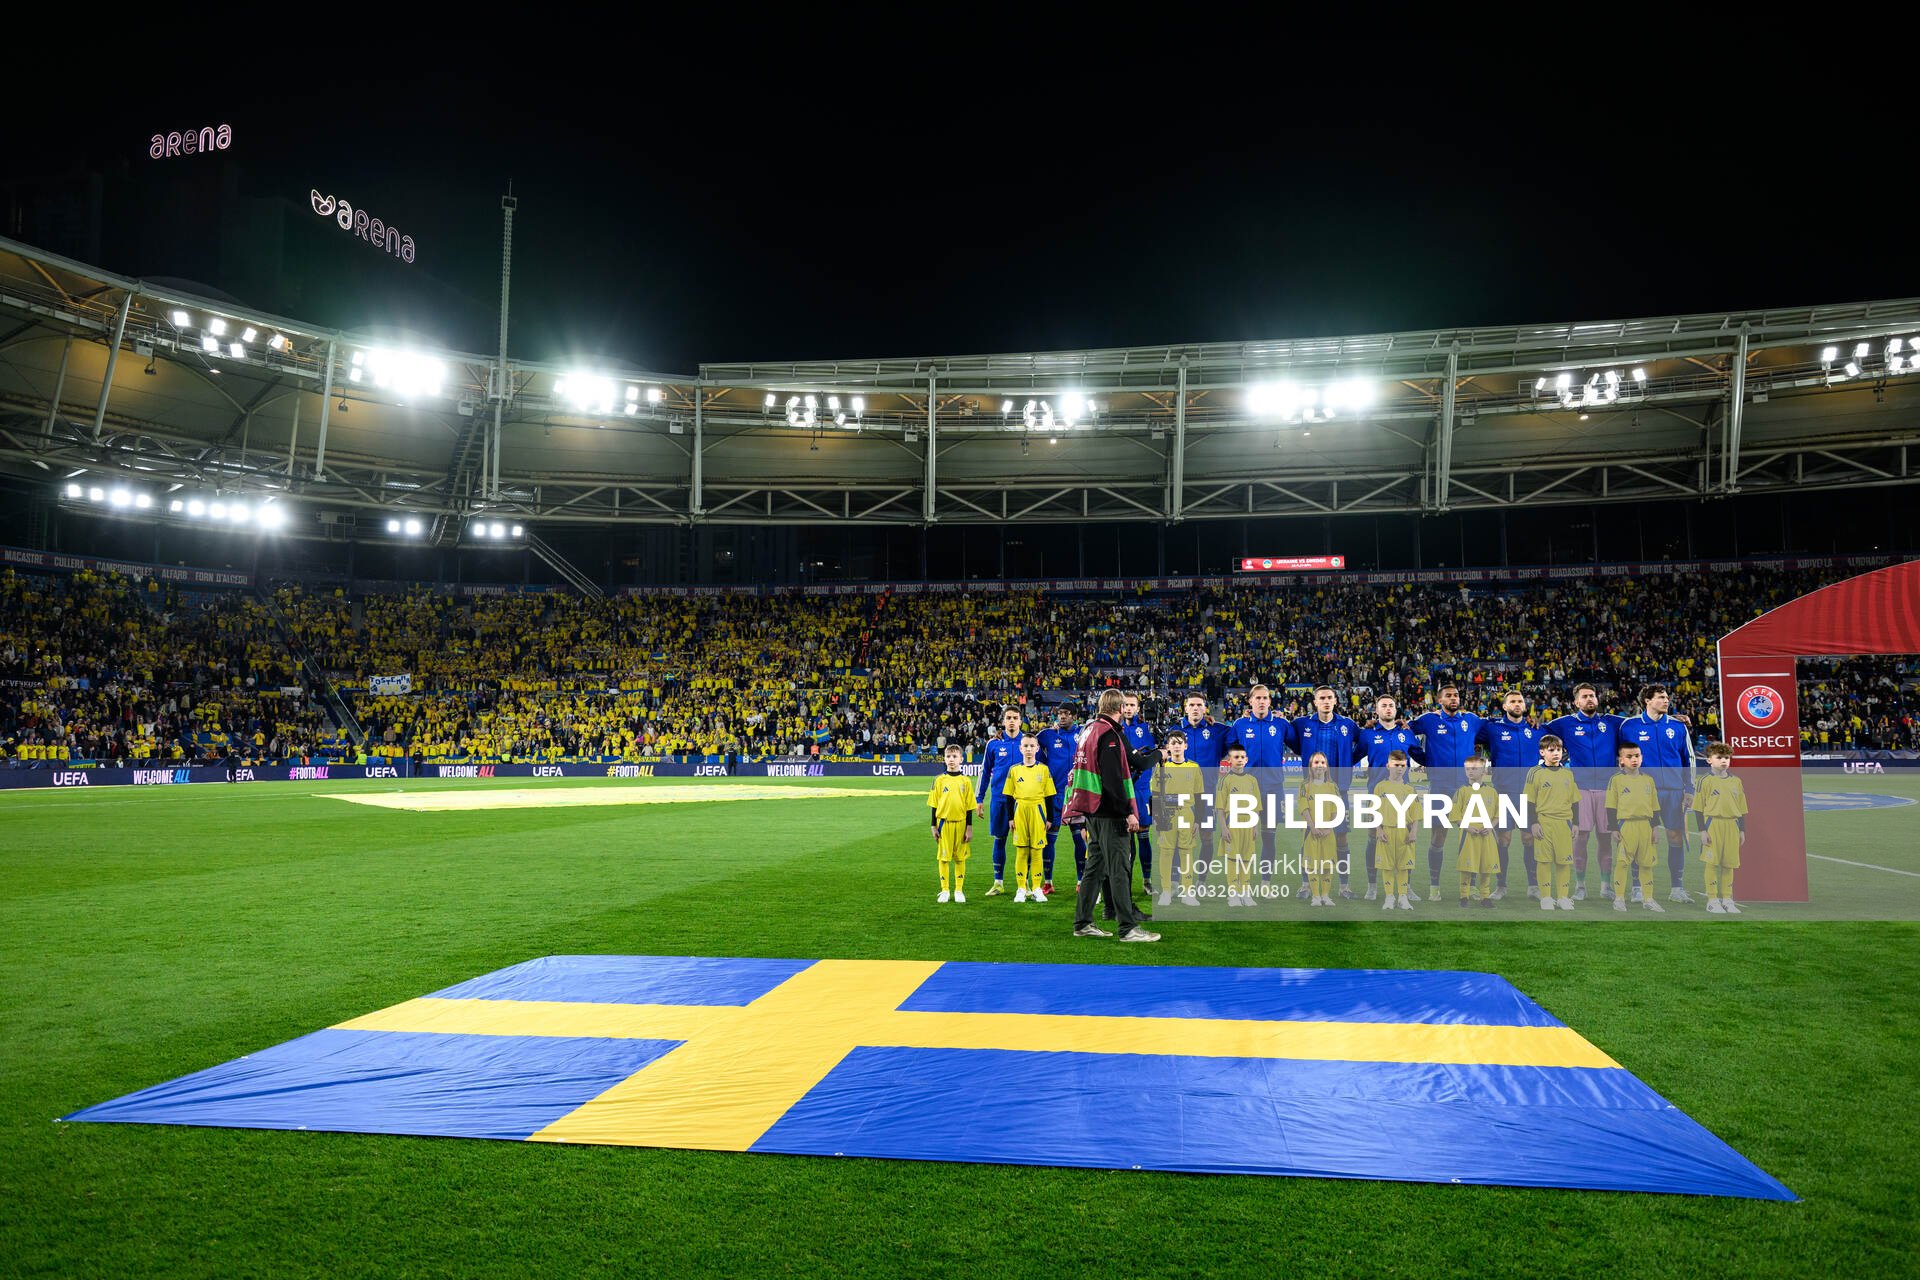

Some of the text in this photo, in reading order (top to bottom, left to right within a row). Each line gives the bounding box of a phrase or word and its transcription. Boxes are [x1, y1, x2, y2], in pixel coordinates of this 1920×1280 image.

[1746, 688, 1774, 698] UEFA
[1731, 735, 1794, 748] RESPECT
[289, 766, 329, 780] #FOOTBALL
[365, 767, 398, 778] UEFA
[439, 765, 495, 778] WELCOME ALL
[533, 767, 564, 777] UEFA
[607, 765, 654, 777] #FOOTBALL
[696, 765, 728, 776] UEFA
[767, 764, 824, 777] WELCOME ALL
[873, 765, 904, 776] UEFA
[1843, 762, 1885, 774] UEFA
[53, 772, 89, 785] UEFA
[133, 769, 191, 785] WELCOME ALL
